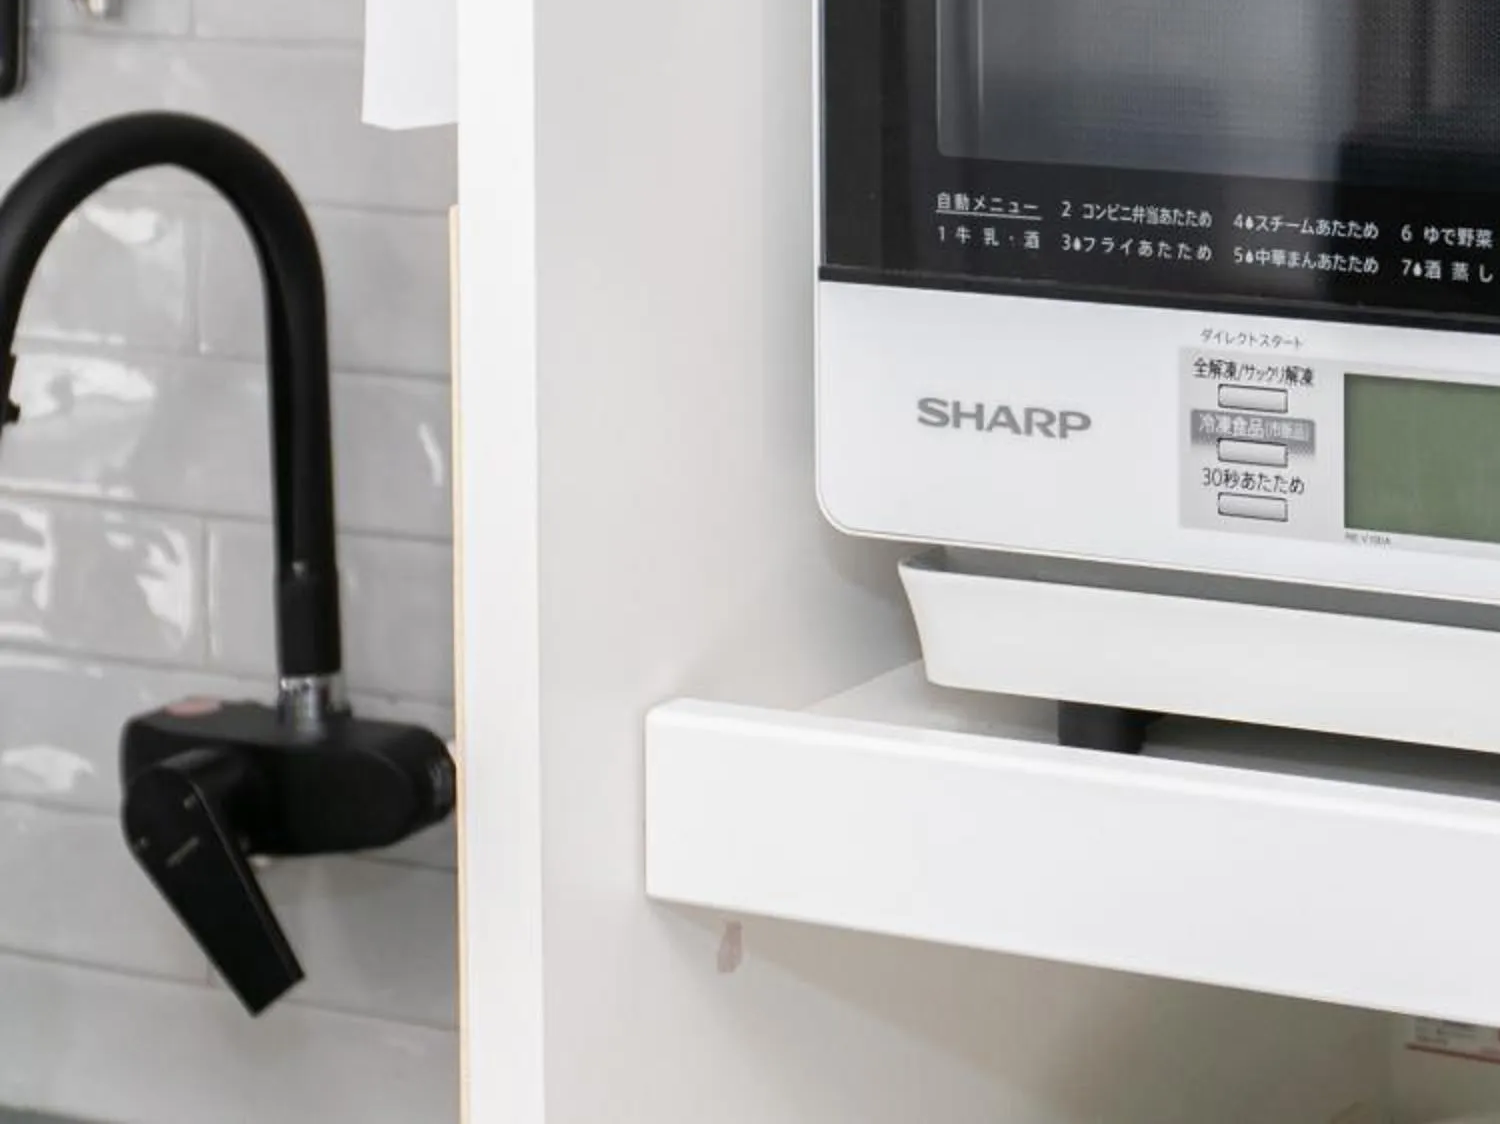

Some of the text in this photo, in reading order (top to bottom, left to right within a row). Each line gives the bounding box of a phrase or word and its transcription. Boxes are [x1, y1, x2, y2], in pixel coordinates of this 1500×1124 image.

[937, 191, 1041, 213] 自動メニュー
[1082, 203, 1213, 228] コンビニ弁当あたため
[1255, 214, 1379, 241] スチームあたため
[1083, 235, 1213, 262] フライあたため
[1424, 226, 1494, 249] ゆで野菜
[1255, 248, 1379, 274] 中華まんあたため
[1200, 327, 1303, 351] ダイレクトスタート
[916, 396, 1092, 439] SHARP
[1200, 466, 1306, 496] 30秒あたため
